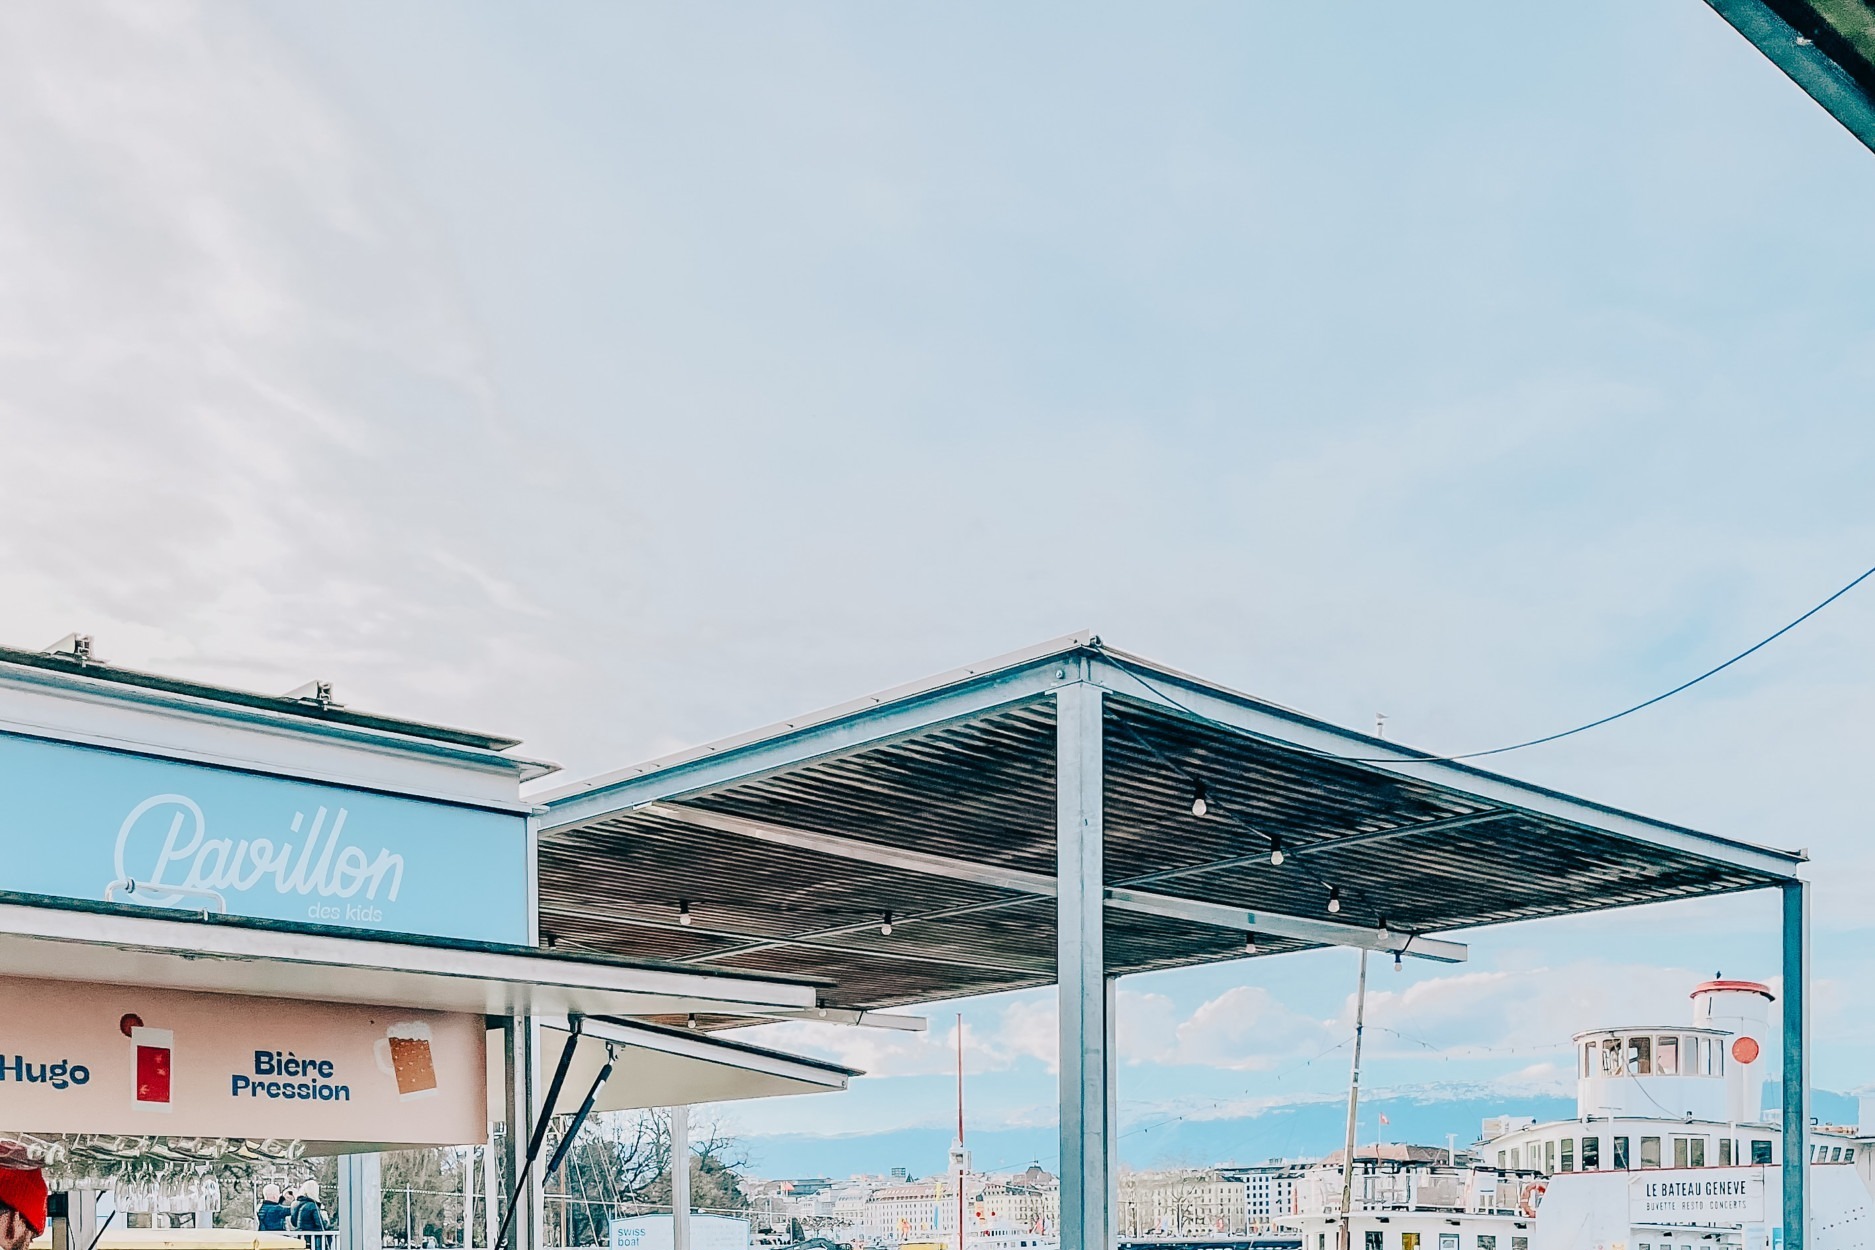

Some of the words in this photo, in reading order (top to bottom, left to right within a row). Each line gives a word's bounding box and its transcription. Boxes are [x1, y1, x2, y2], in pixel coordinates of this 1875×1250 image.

[114, 793, 404, 907] Pavillon
[308, 902, 341, 920] des
[345, 903, 382, 922] kids
[0, 1054, 90, 1090] Hugo
[254, 1050, 334, 1078] Bière
[231, 1074, 350, 1101] Pression
[1646, 1183, 1657, 1197] LE
[1661, 1182, 1701, 1197] BATEAU
[1705, 1180, 1746, 1196] GENEVE
[1646, 1201, 1676, 1211] BUVETTE
[1681, 1201, 1704, 1211] RESTO
[1709, 1200, 1747, 1210] CONCERTS
[617, 1237, 640, 1247] boat
